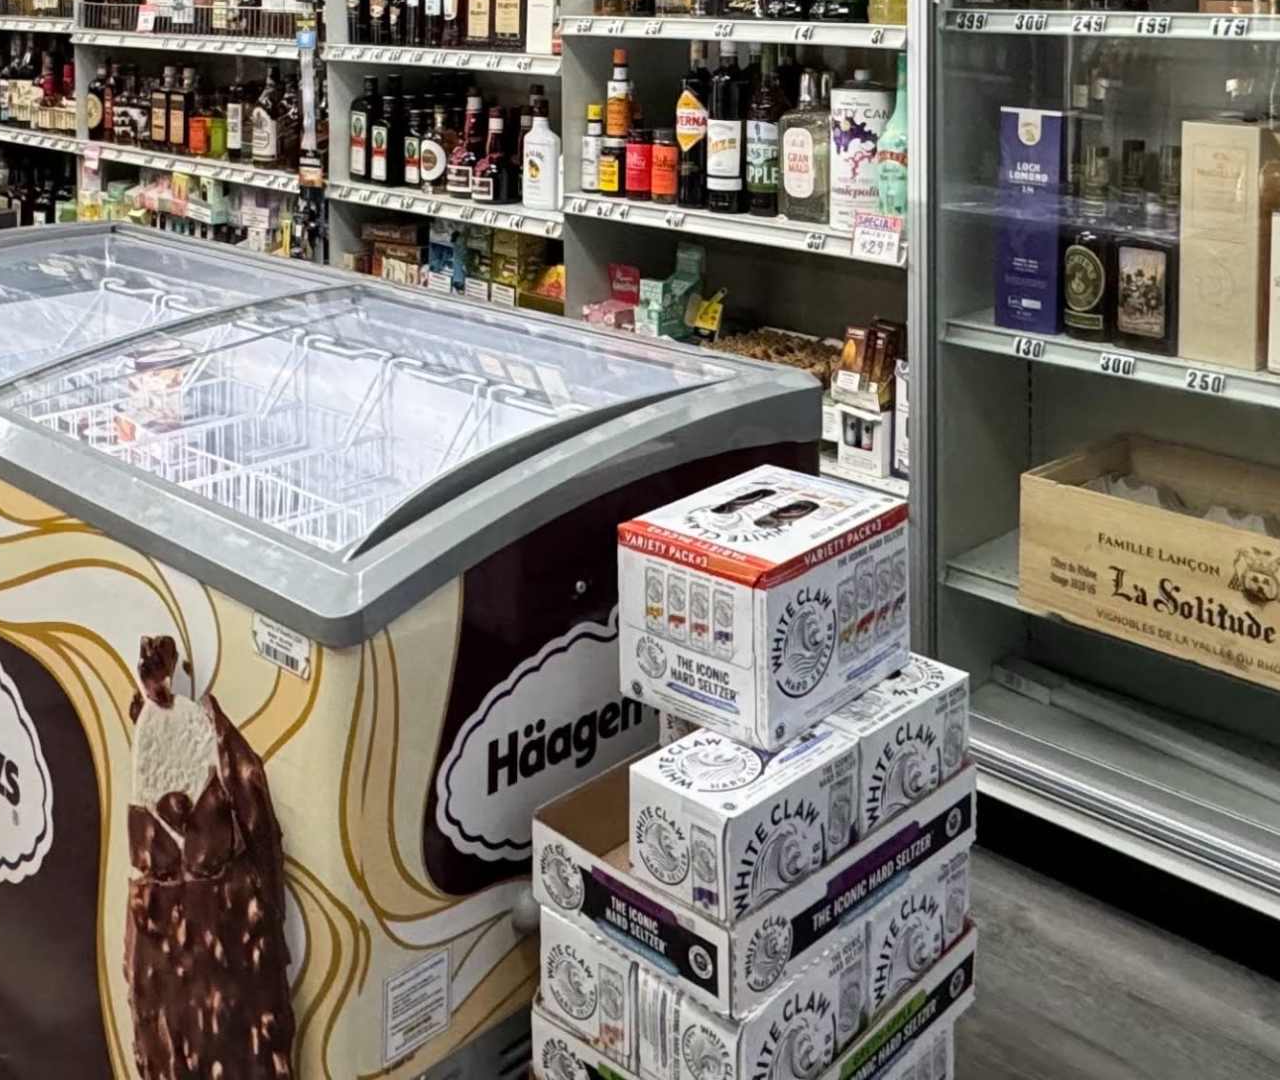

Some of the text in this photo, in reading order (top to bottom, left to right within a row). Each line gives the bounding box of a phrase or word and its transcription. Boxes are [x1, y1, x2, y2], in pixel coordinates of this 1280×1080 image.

[1008, 171, 1048, 183] LOMOND
[1017, 162, 1041, 173] LOCH
[1015, 336, 1043, 358] 130
[1101, 356, 1133, 375] 300
[1187, 370, 1222, 394] 250
[624, 531, 669, 556] VARIETY
[804, 538, 846, 568] VARIETY
[1098, 532, 1221, 577] FAMILLE LANÇON
[1109, 565, 1278, 645] La Solitude
[771, 589, 832, 674] WHITE CLAW
[1096, 607, 1156, 637] VIGNOBLES
[1157, 628, 1173, 642] DE
[1174, 632, 1190, 646] LA
[669, 667, 738, 703] HARD SELTZER
[676, 654, 731, 687] THE ICONIC
[658, 737, 722, 791] WHITE CLAW
[866, 722, 937, 829] WHITE CLAW
[636, 806, 685, 844] WHITE CLAW
[735, 799, 820, 919] WHITE CLAW
[812, 833, 934, 932] THE ICONIC HARD SELTZER
[605, 906, 668, 954] HARD SELTZER
[610, 896, 659, 934] THE ICONIC
[547, 944, 594, 981] WHITE CLAW
[874, 894, 938, 1009] WHITE CLAW
[782, 991, 831, 1022] CLAW
